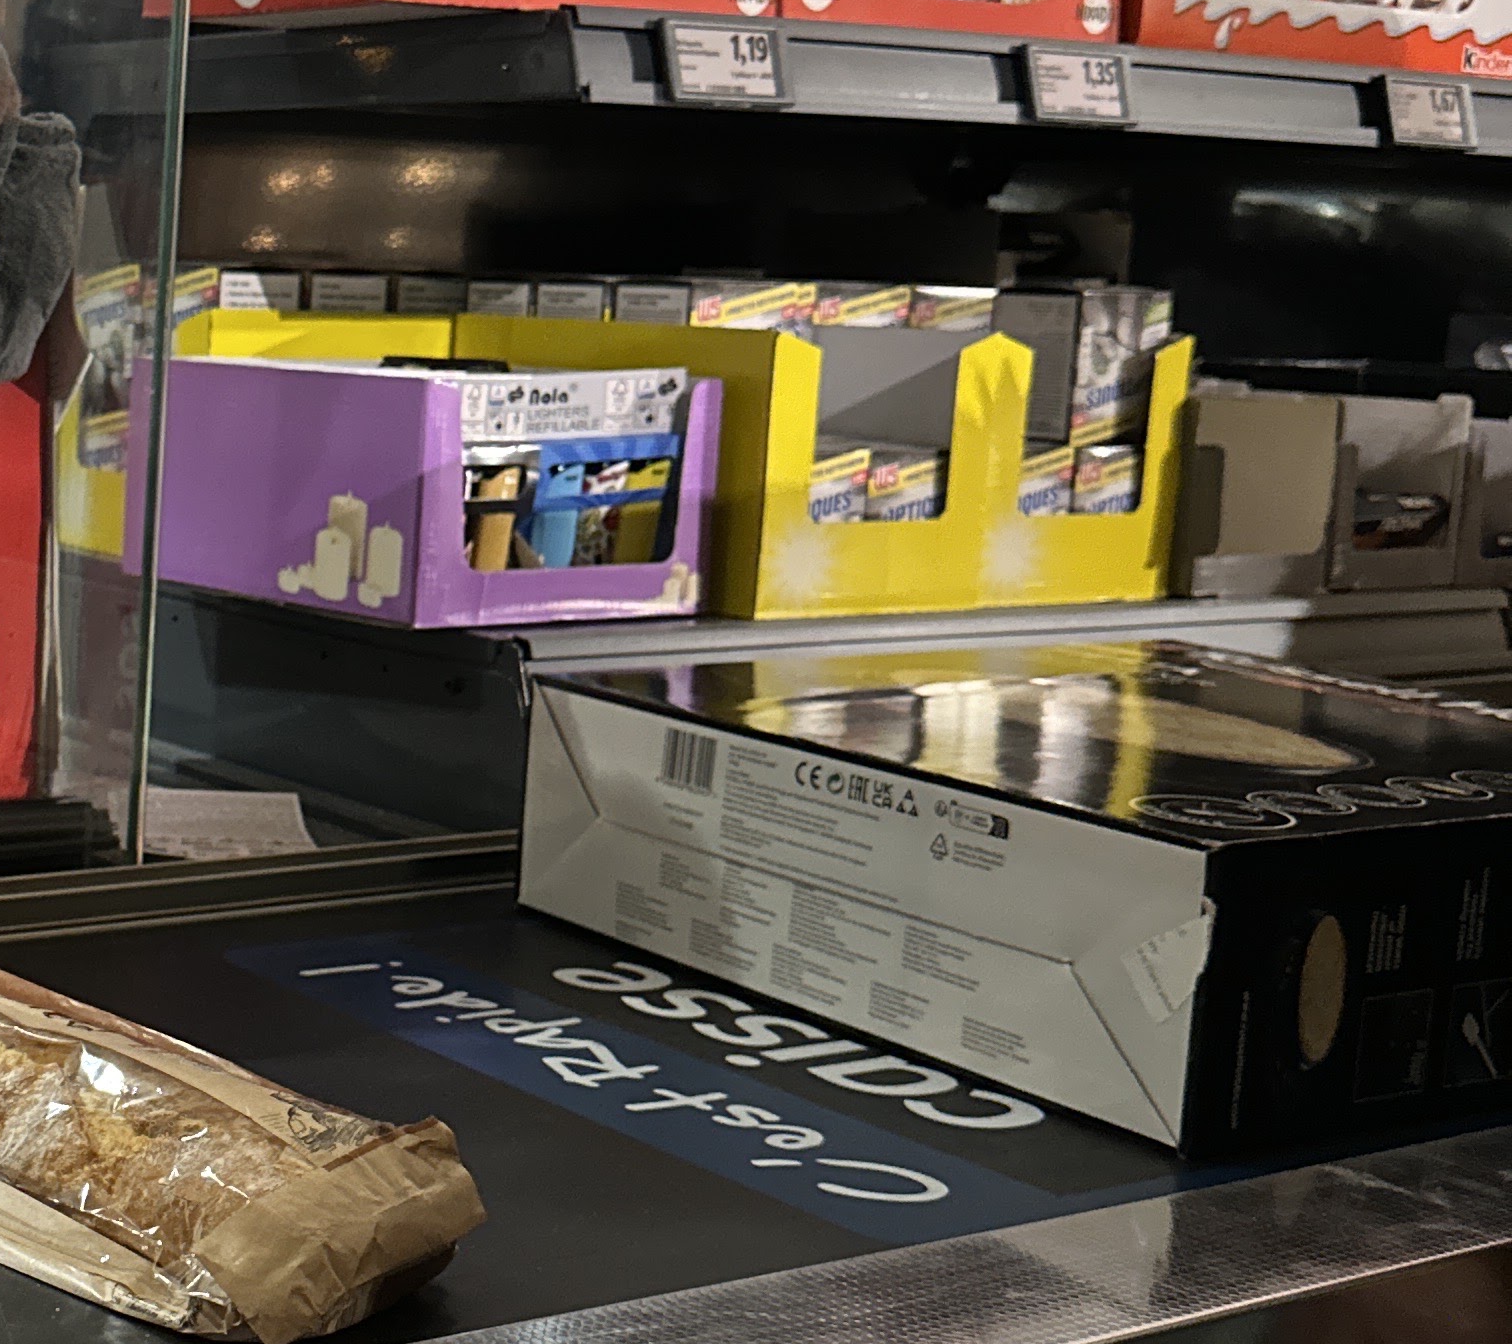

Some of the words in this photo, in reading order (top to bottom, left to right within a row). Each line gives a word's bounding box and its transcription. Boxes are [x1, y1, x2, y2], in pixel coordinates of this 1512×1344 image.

[730, 35, 768, 66] 1,19
[1083, 60, 1115, 88] 1,35
[794, 761, 822, 791] CE
[391, 973, 661, 1088] Rapide
[625, 1087, 949, 1204] C'est
